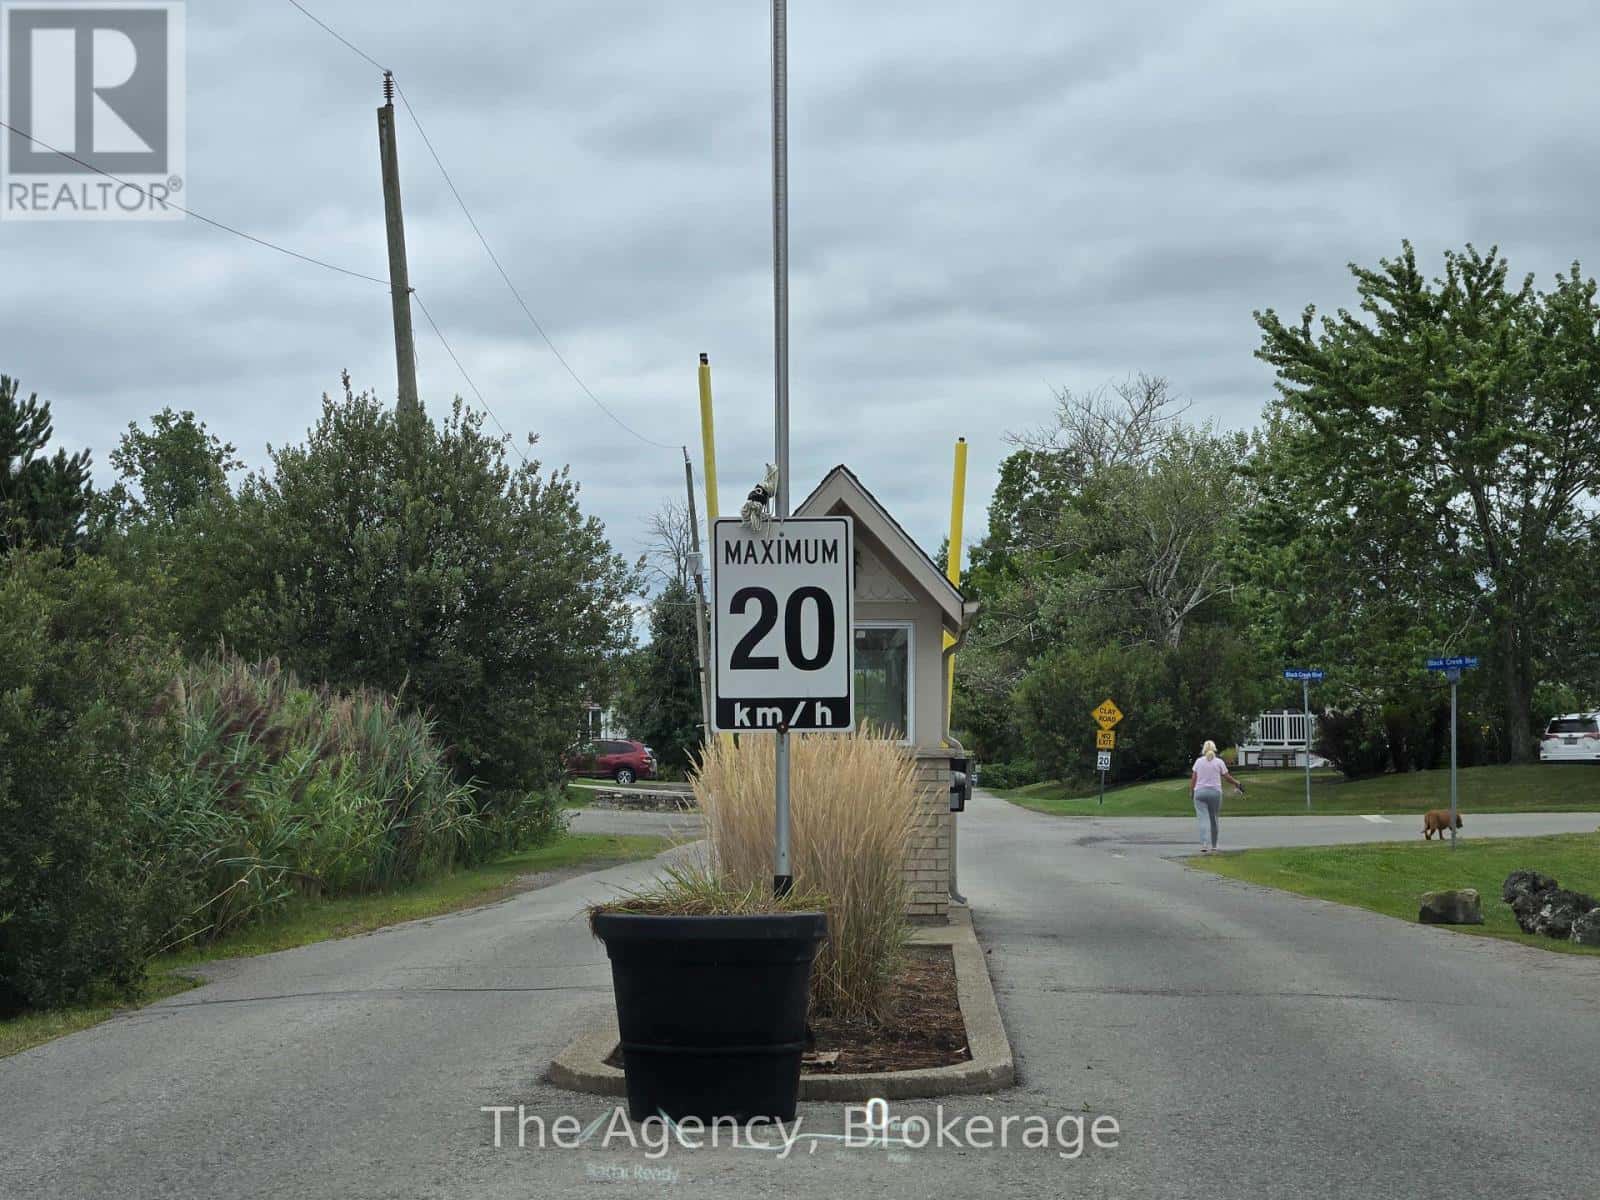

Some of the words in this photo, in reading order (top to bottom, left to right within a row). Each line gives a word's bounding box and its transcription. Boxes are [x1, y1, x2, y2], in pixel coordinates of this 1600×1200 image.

[725, 539, 839, 565] MAXIMUM
[729, 585, 836, 671] 20
[734, 701, 833, 727] km/h
[1099, 756, 1110, 766] 20
